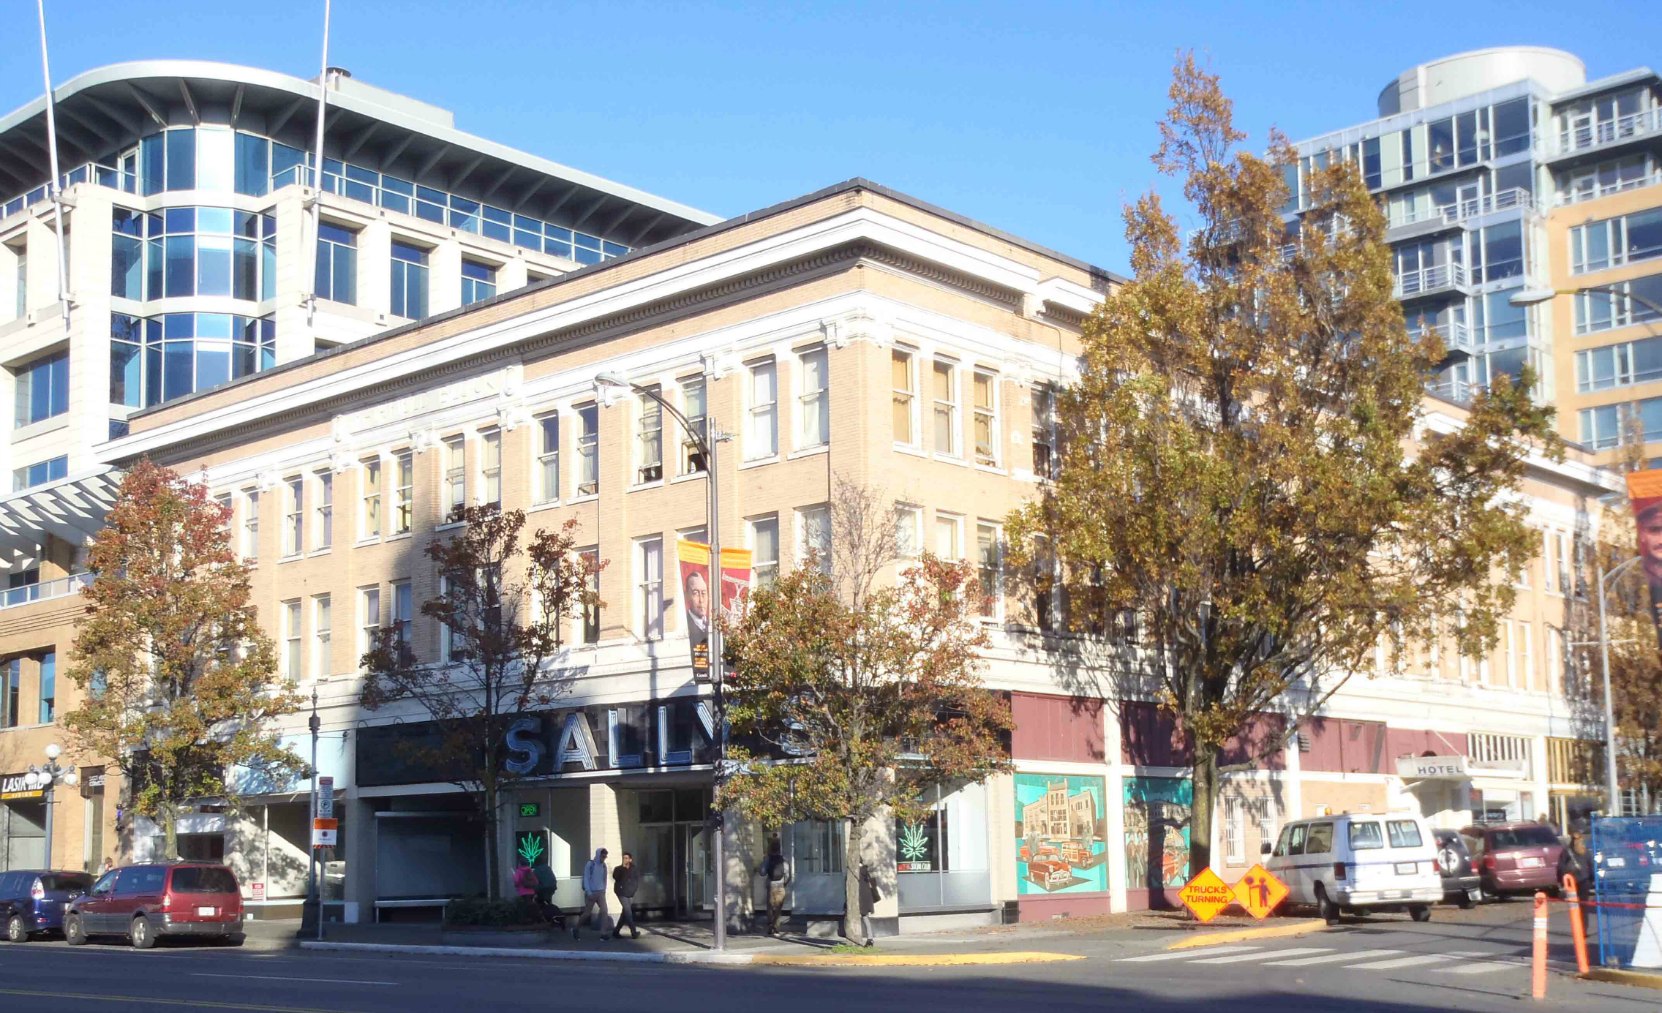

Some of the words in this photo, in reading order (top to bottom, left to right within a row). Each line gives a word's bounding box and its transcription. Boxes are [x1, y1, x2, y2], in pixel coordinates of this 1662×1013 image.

[1418, 765, 1464, 774] HOTEL
[2, 776, 27, 792] LASIK
[1188, 885, 1227, 894] TRUCKS
[1186, 895, 1228, 904] TURNING
